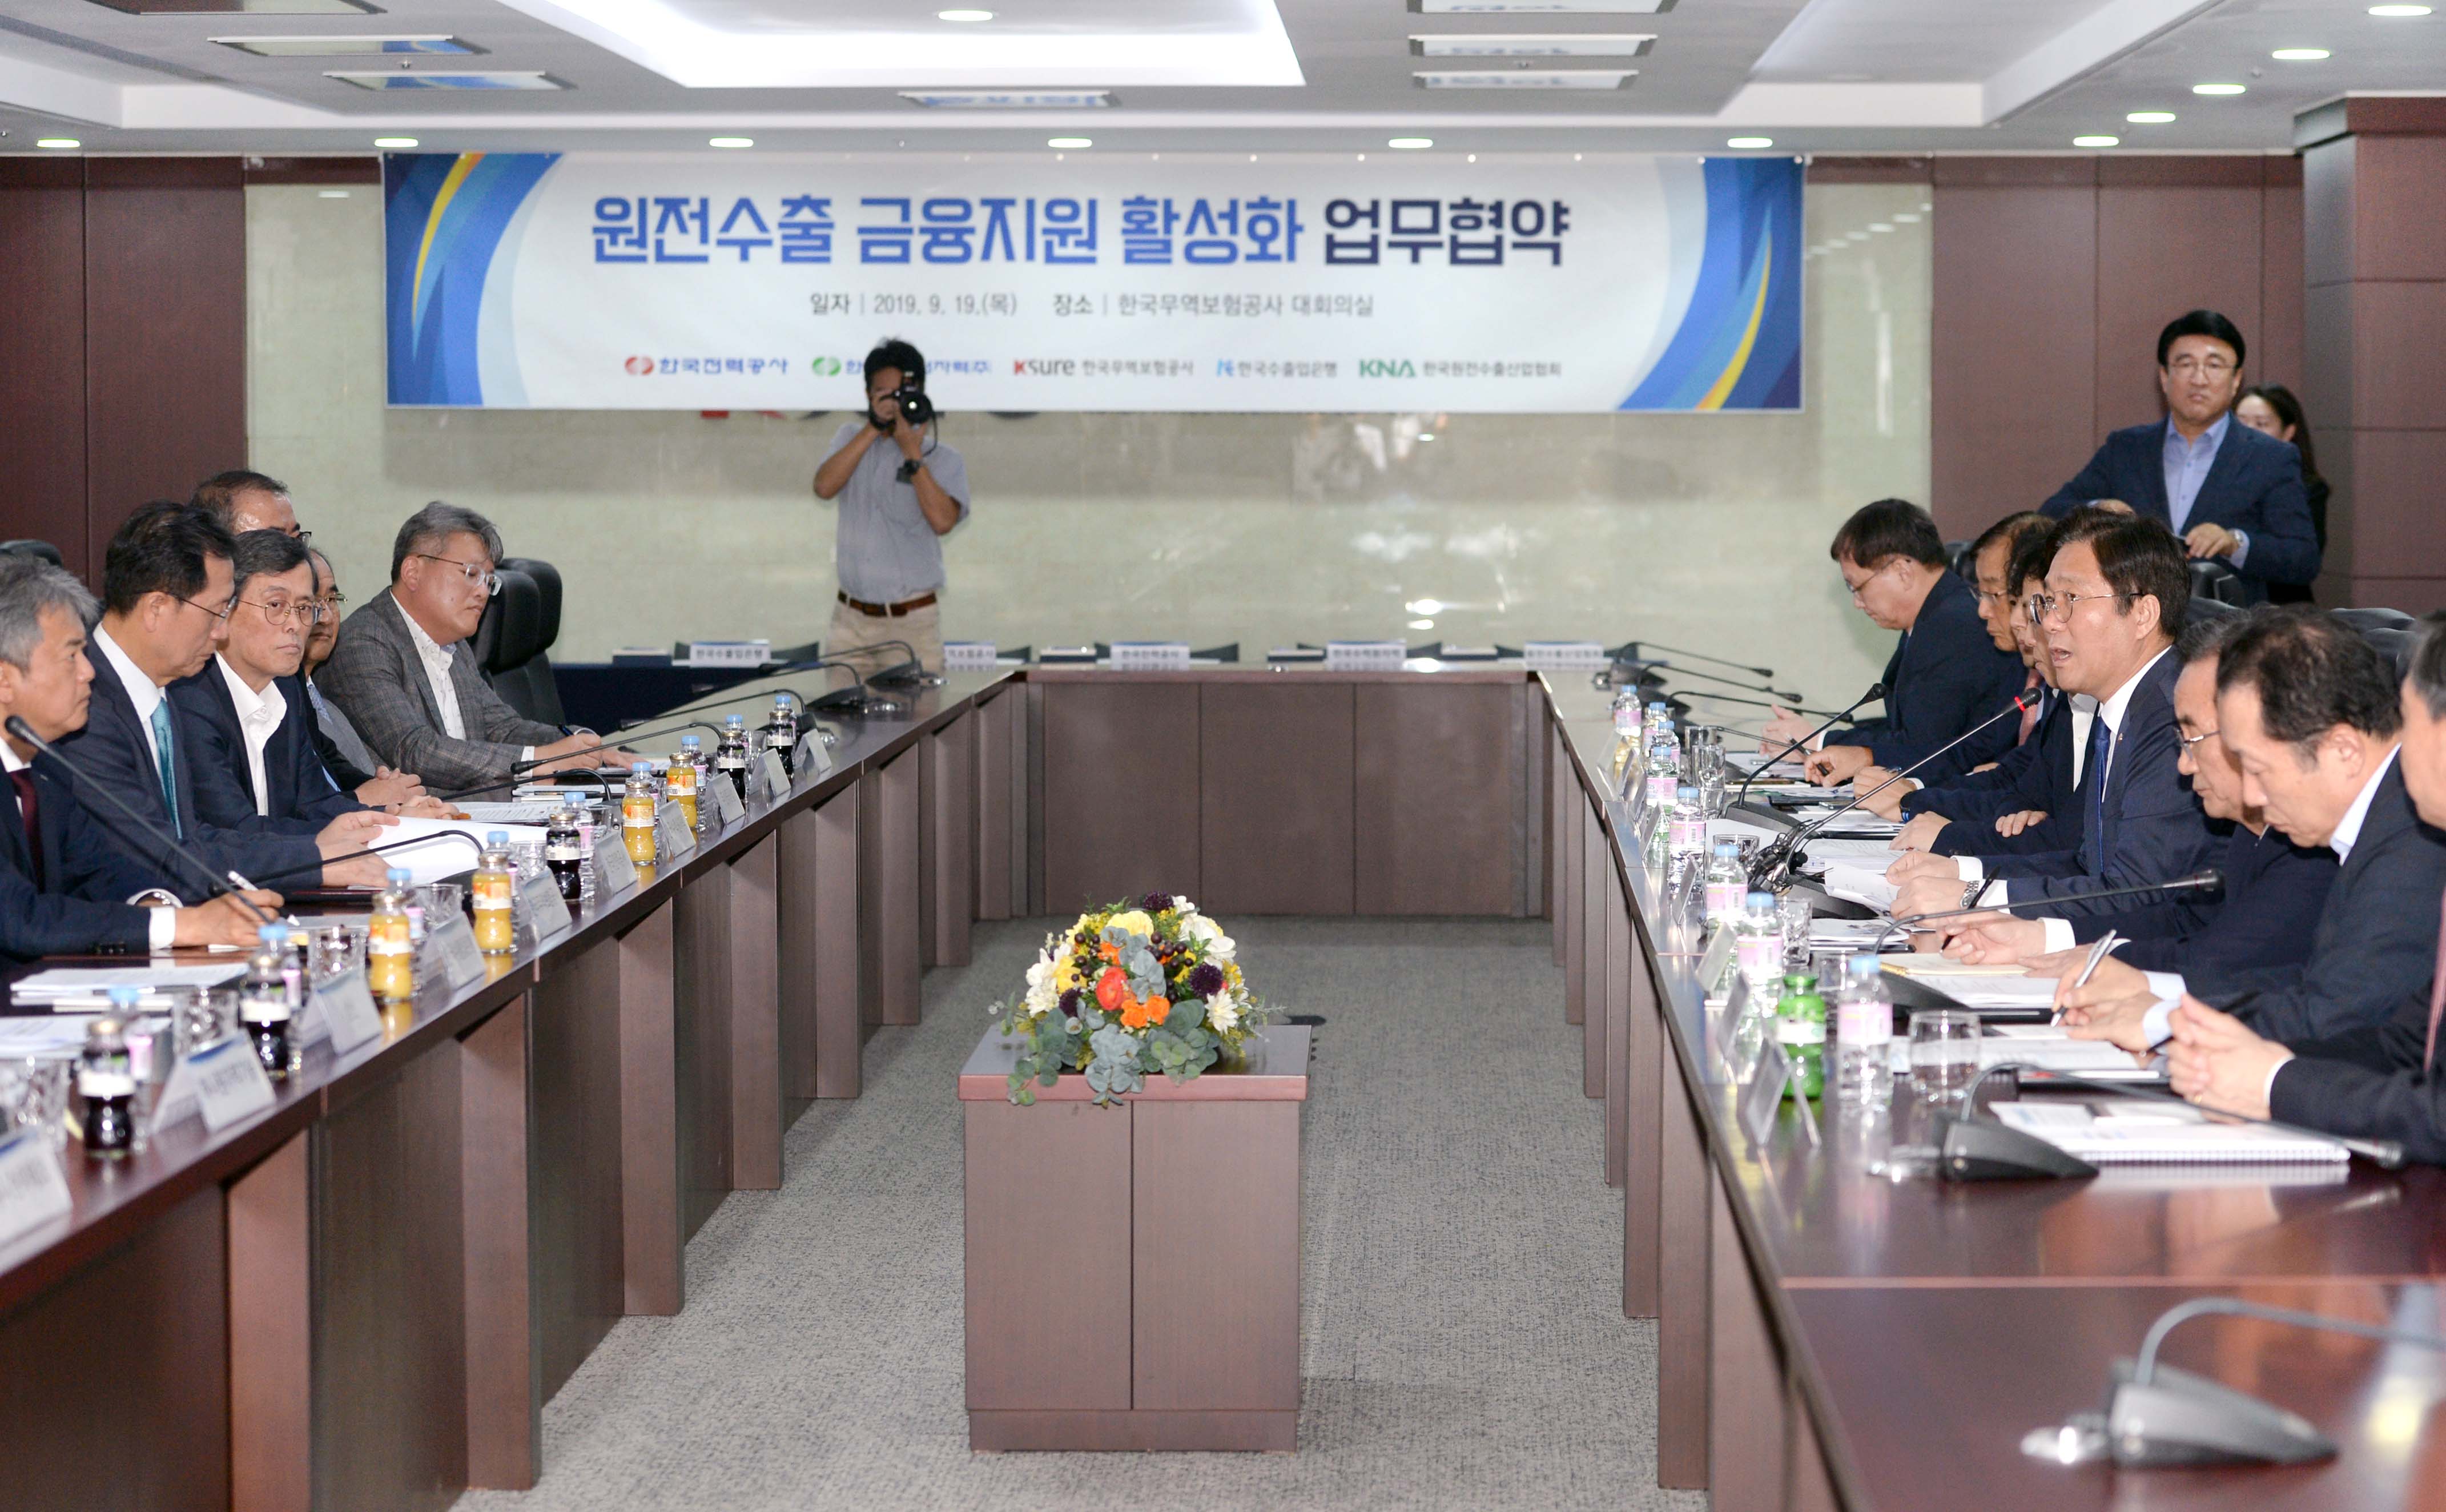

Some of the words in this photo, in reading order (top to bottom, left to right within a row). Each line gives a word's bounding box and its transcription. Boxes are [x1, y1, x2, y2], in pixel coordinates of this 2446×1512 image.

[592, 195, 834, 263] 원전수출
[858, 198, 1097, 263] 금융지원
[1121, 196, 1304, 264] 활성화
[1325, 197, 1570, 266] 업무협약
[810, 293, 850, 315] 일자
[874, 293, 922, 315] 2019.
[929, 294, 946, 315] 9.
[1053, 293, 1093, 317] 장소
[1119, 293, 1283, 317] 한국무역보험공사
[1292, 294, 1374, 317] 대회의실
[659, 357, 788, 375] 한국전력공사
[1358, 359, 1417, 378] KNA
